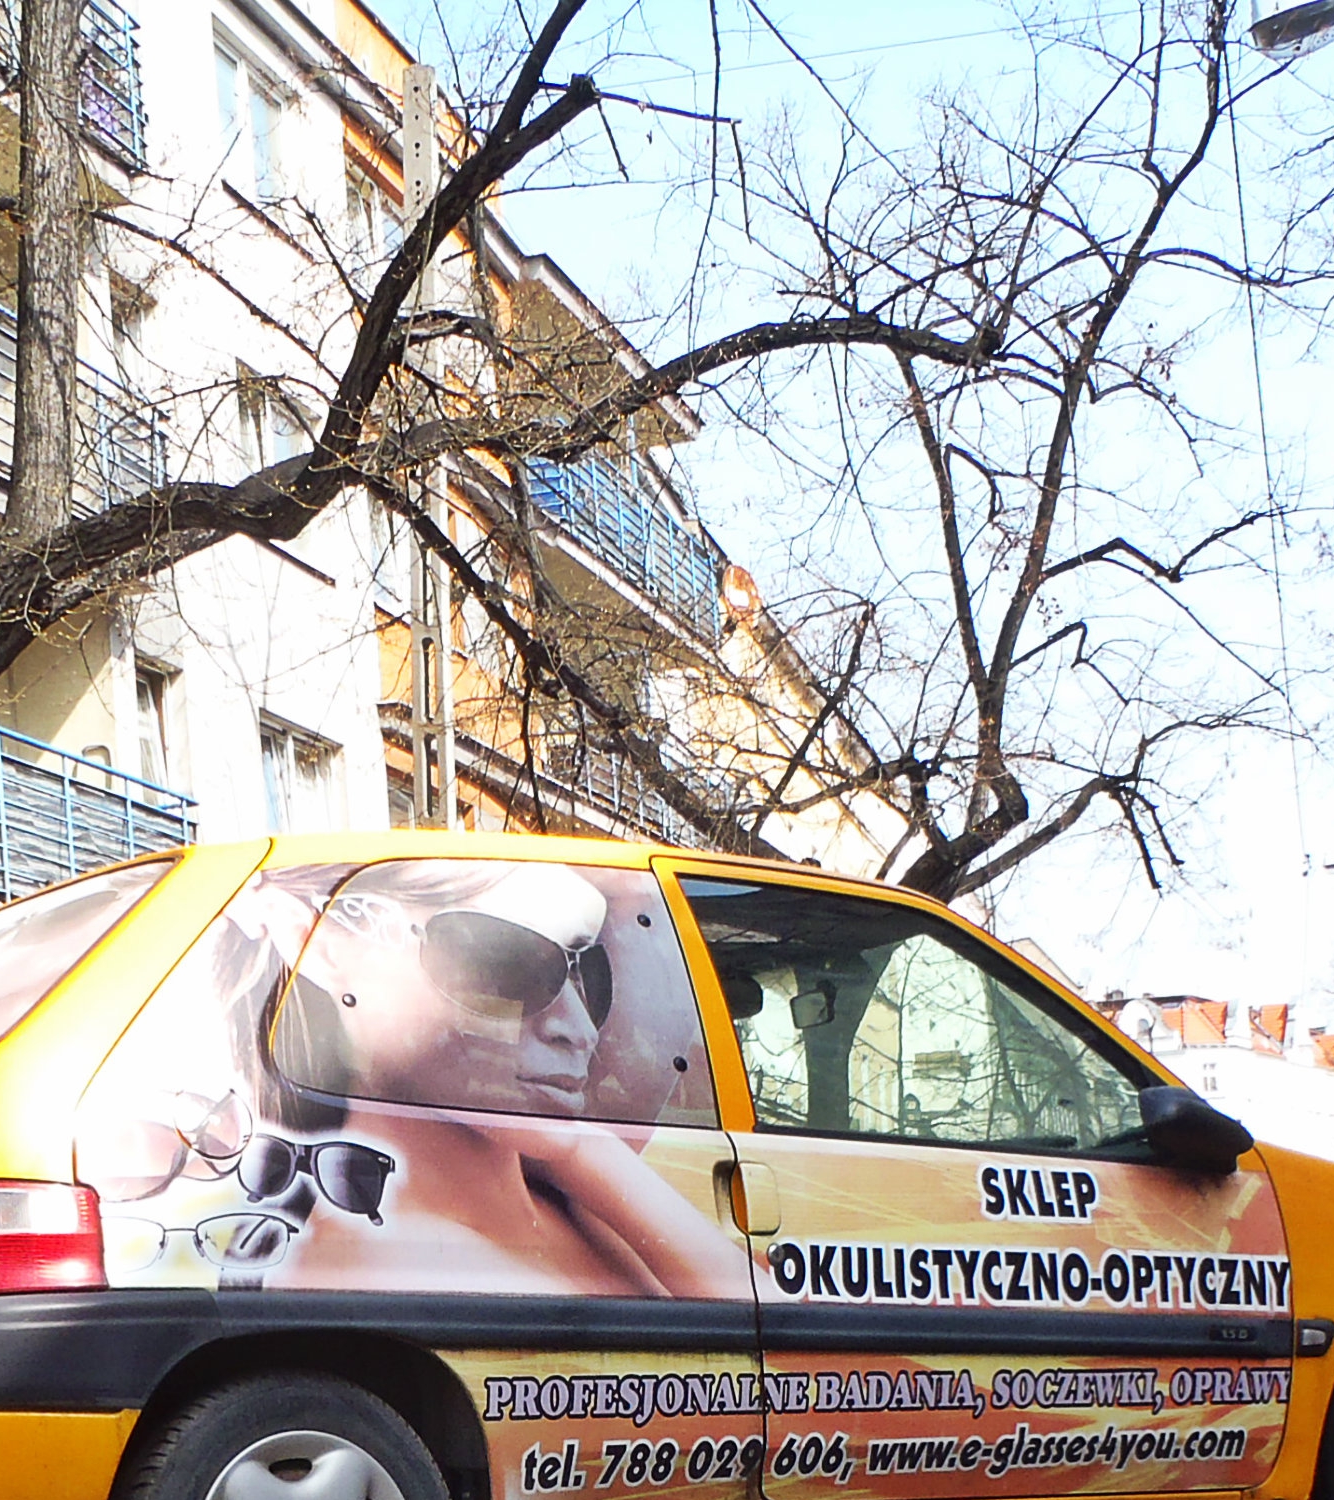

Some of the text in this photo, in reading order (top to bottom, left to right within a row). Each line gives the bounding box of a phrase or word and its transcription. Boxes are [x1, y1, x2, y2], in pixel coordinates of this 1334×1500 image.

[981, 1165, 1097, 1221] SKLEP
[777, 1243, 1290, 1309] OKULISTYCZNO-OPTYCZNY
[484, 1366, 1292, 1426] PROFESJONALNE BADANIA, SOCZEWKI, OPRAWY
[522, 1424, 1246, 1493] tel. 788 029 606, www.e-glasses4you.com
